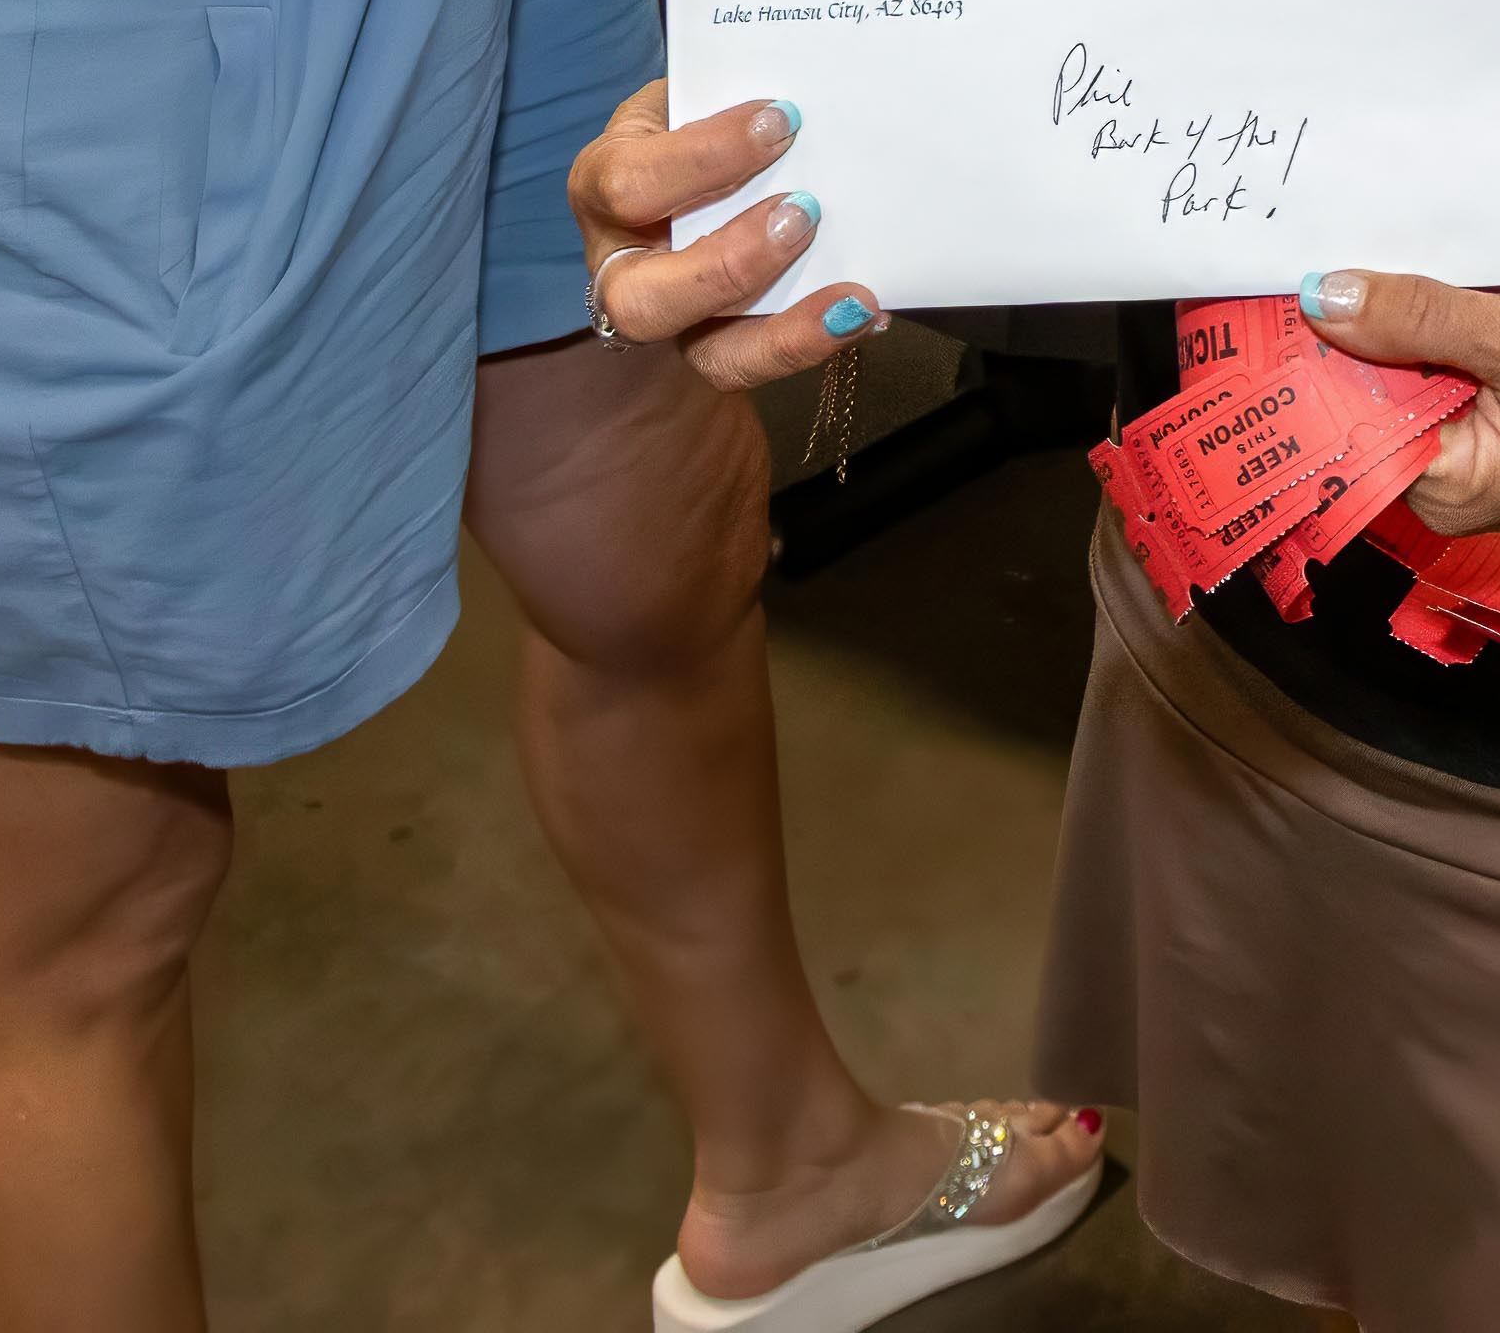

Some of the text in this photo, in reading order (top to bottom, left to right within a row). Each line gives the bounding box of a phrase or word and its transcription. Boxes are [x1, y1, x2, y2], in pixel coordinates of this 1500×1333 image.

[713, 3, 752, 24] Lake
[758, 5, 822, 23] Havasu
[828, 0, 870, 24] City,
[1196, 385, 1297, 457] COUPON
[1235, 424, 1277, 455] THIS
[1236, 434, 1302, 487] KEEP
